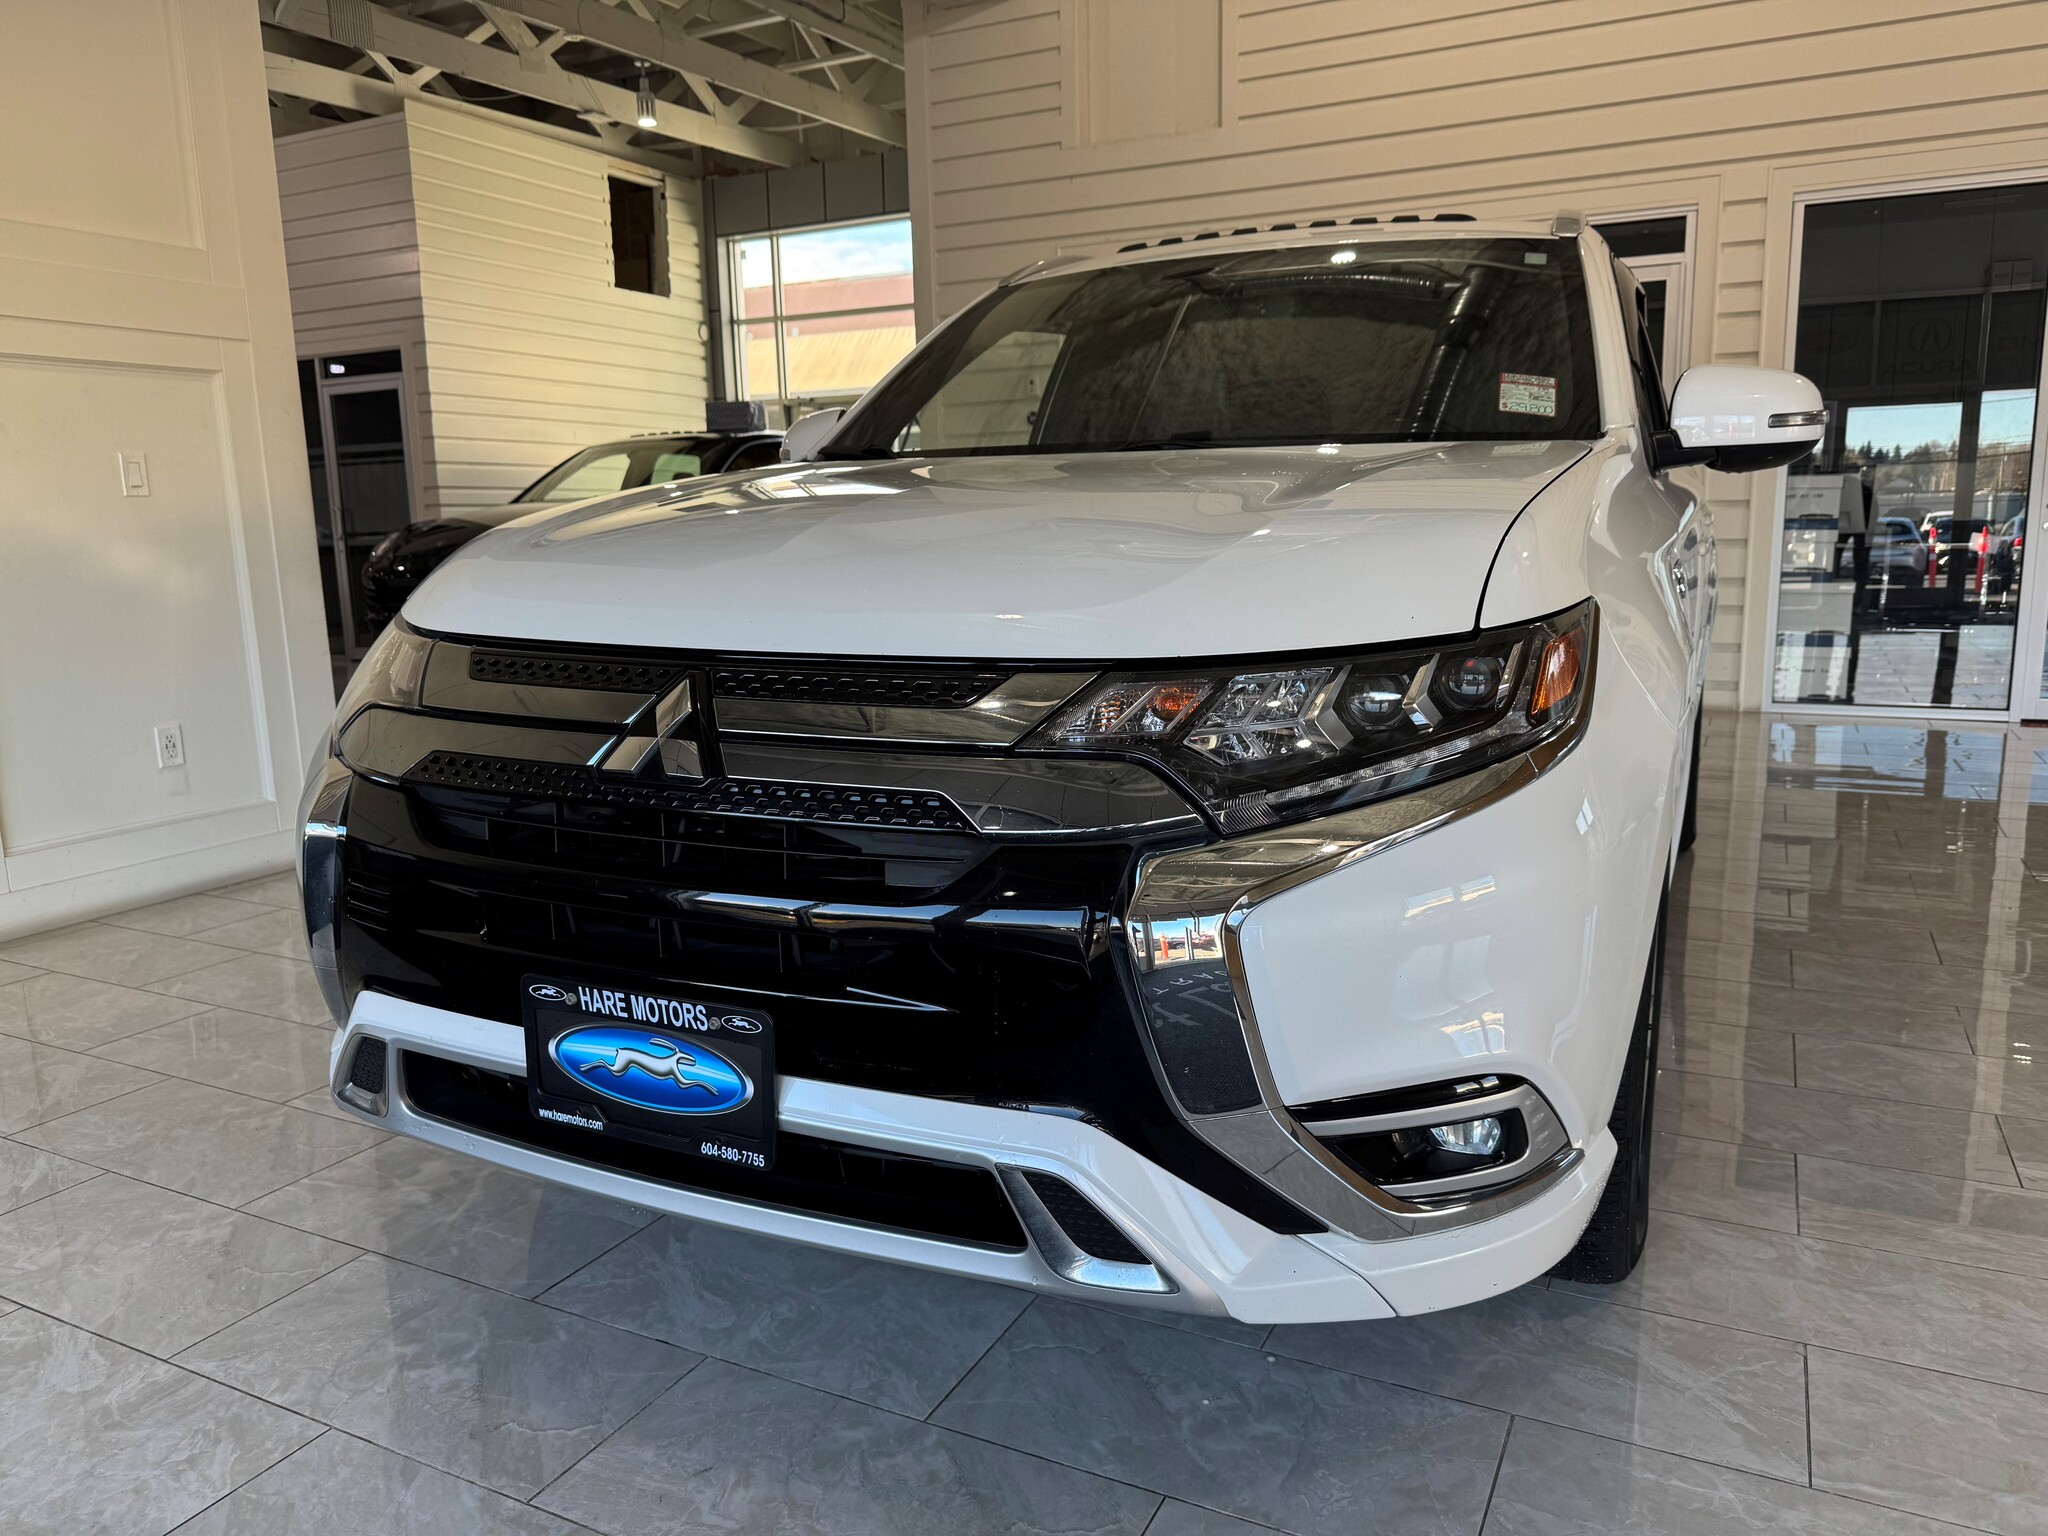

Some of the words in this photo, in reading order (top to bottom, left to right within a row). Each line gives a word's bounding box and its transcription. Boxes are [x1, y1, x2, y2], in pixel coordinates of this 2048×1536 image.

[578, 986, 628, 1018] HARE
[630, 994, 709, 1032] MOTORS
[538, 1107, 604, 1131] www.haremotors.com
[701, 1141, 765, 1168] 604-580-7755
